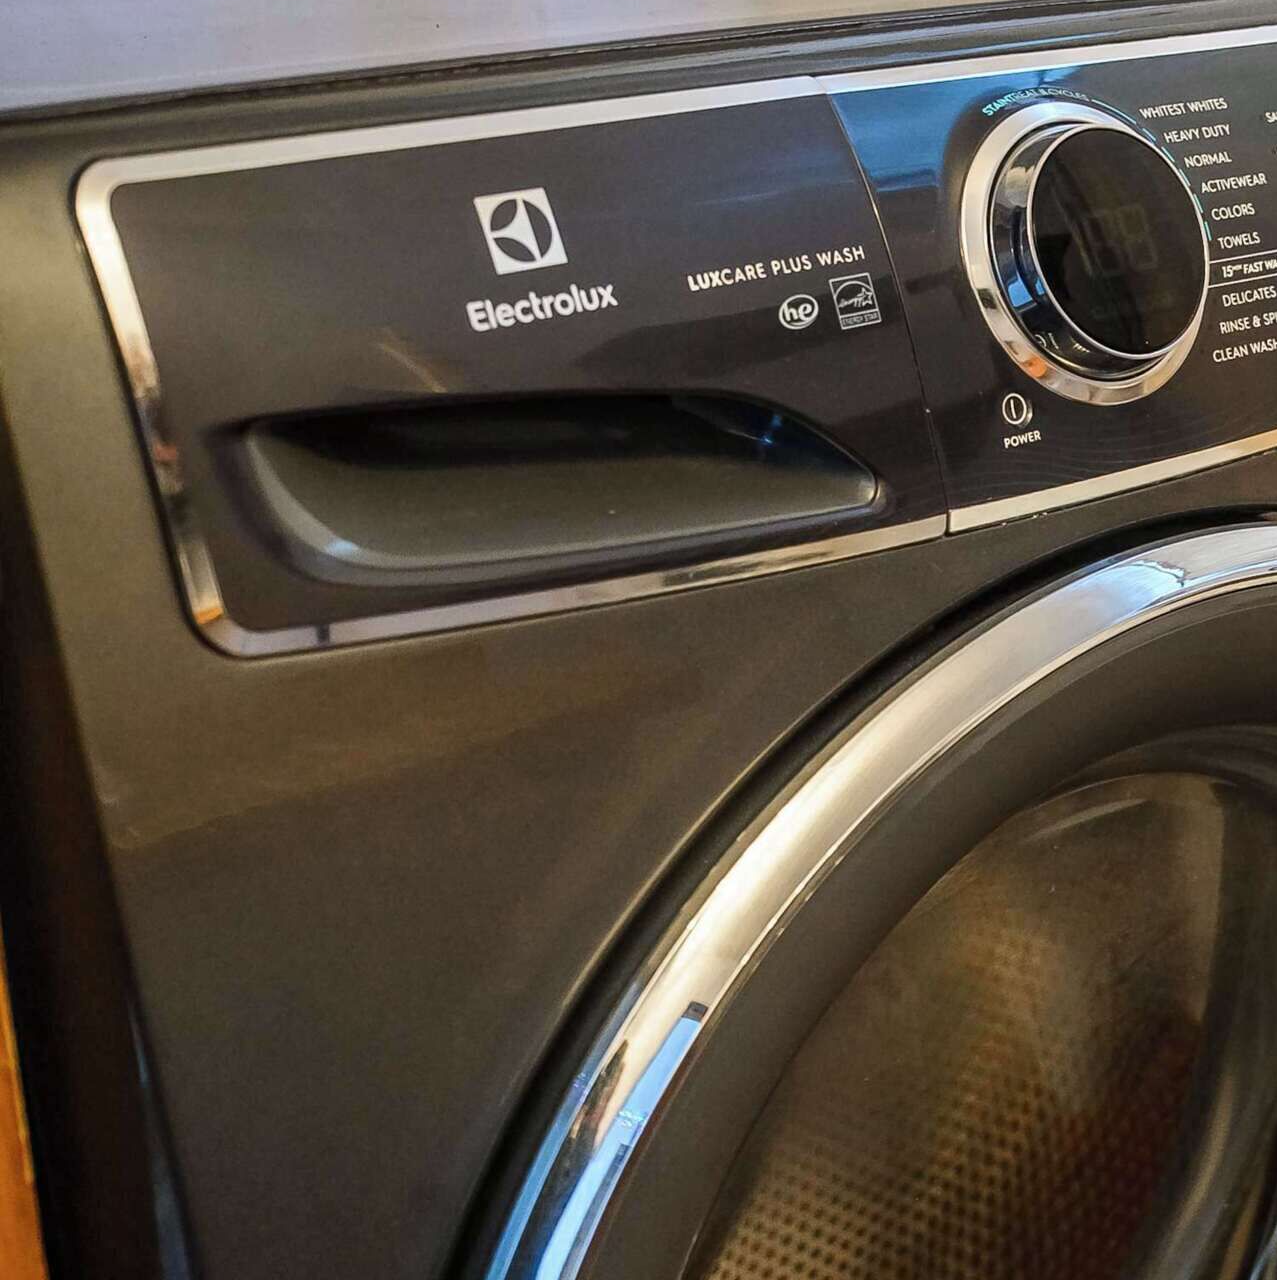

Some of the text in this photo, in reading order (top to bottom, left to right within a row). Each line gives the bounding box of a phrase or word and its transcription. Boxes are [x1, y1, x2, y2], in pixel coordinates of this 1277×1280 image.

[1139, 98, 1228, 119] WHITEST WHITES
[1164, 124, 1231, 144] HEAVY DUTY
[1184, 151, 1232, 168] NORMAL
[1201, 173, 1267, 193] ACTIVEWEAR
[1211, 203, 1255, 220] COLORS
[1218, 231, 1261, 249] TOWELS
[687, 245, 866, 291] LUXCARE PLUS WASH
[1243, 264, 1264, 274] FAST
[1222, 286, 1277, 307] DELICATES
[466, 282, 618, 333] Electrolux
[1220, 317, 1251, 334] RINSE
[1213, 344, 1249, 362] CLEAN
[1003, 430, 1041, 448] POWER
